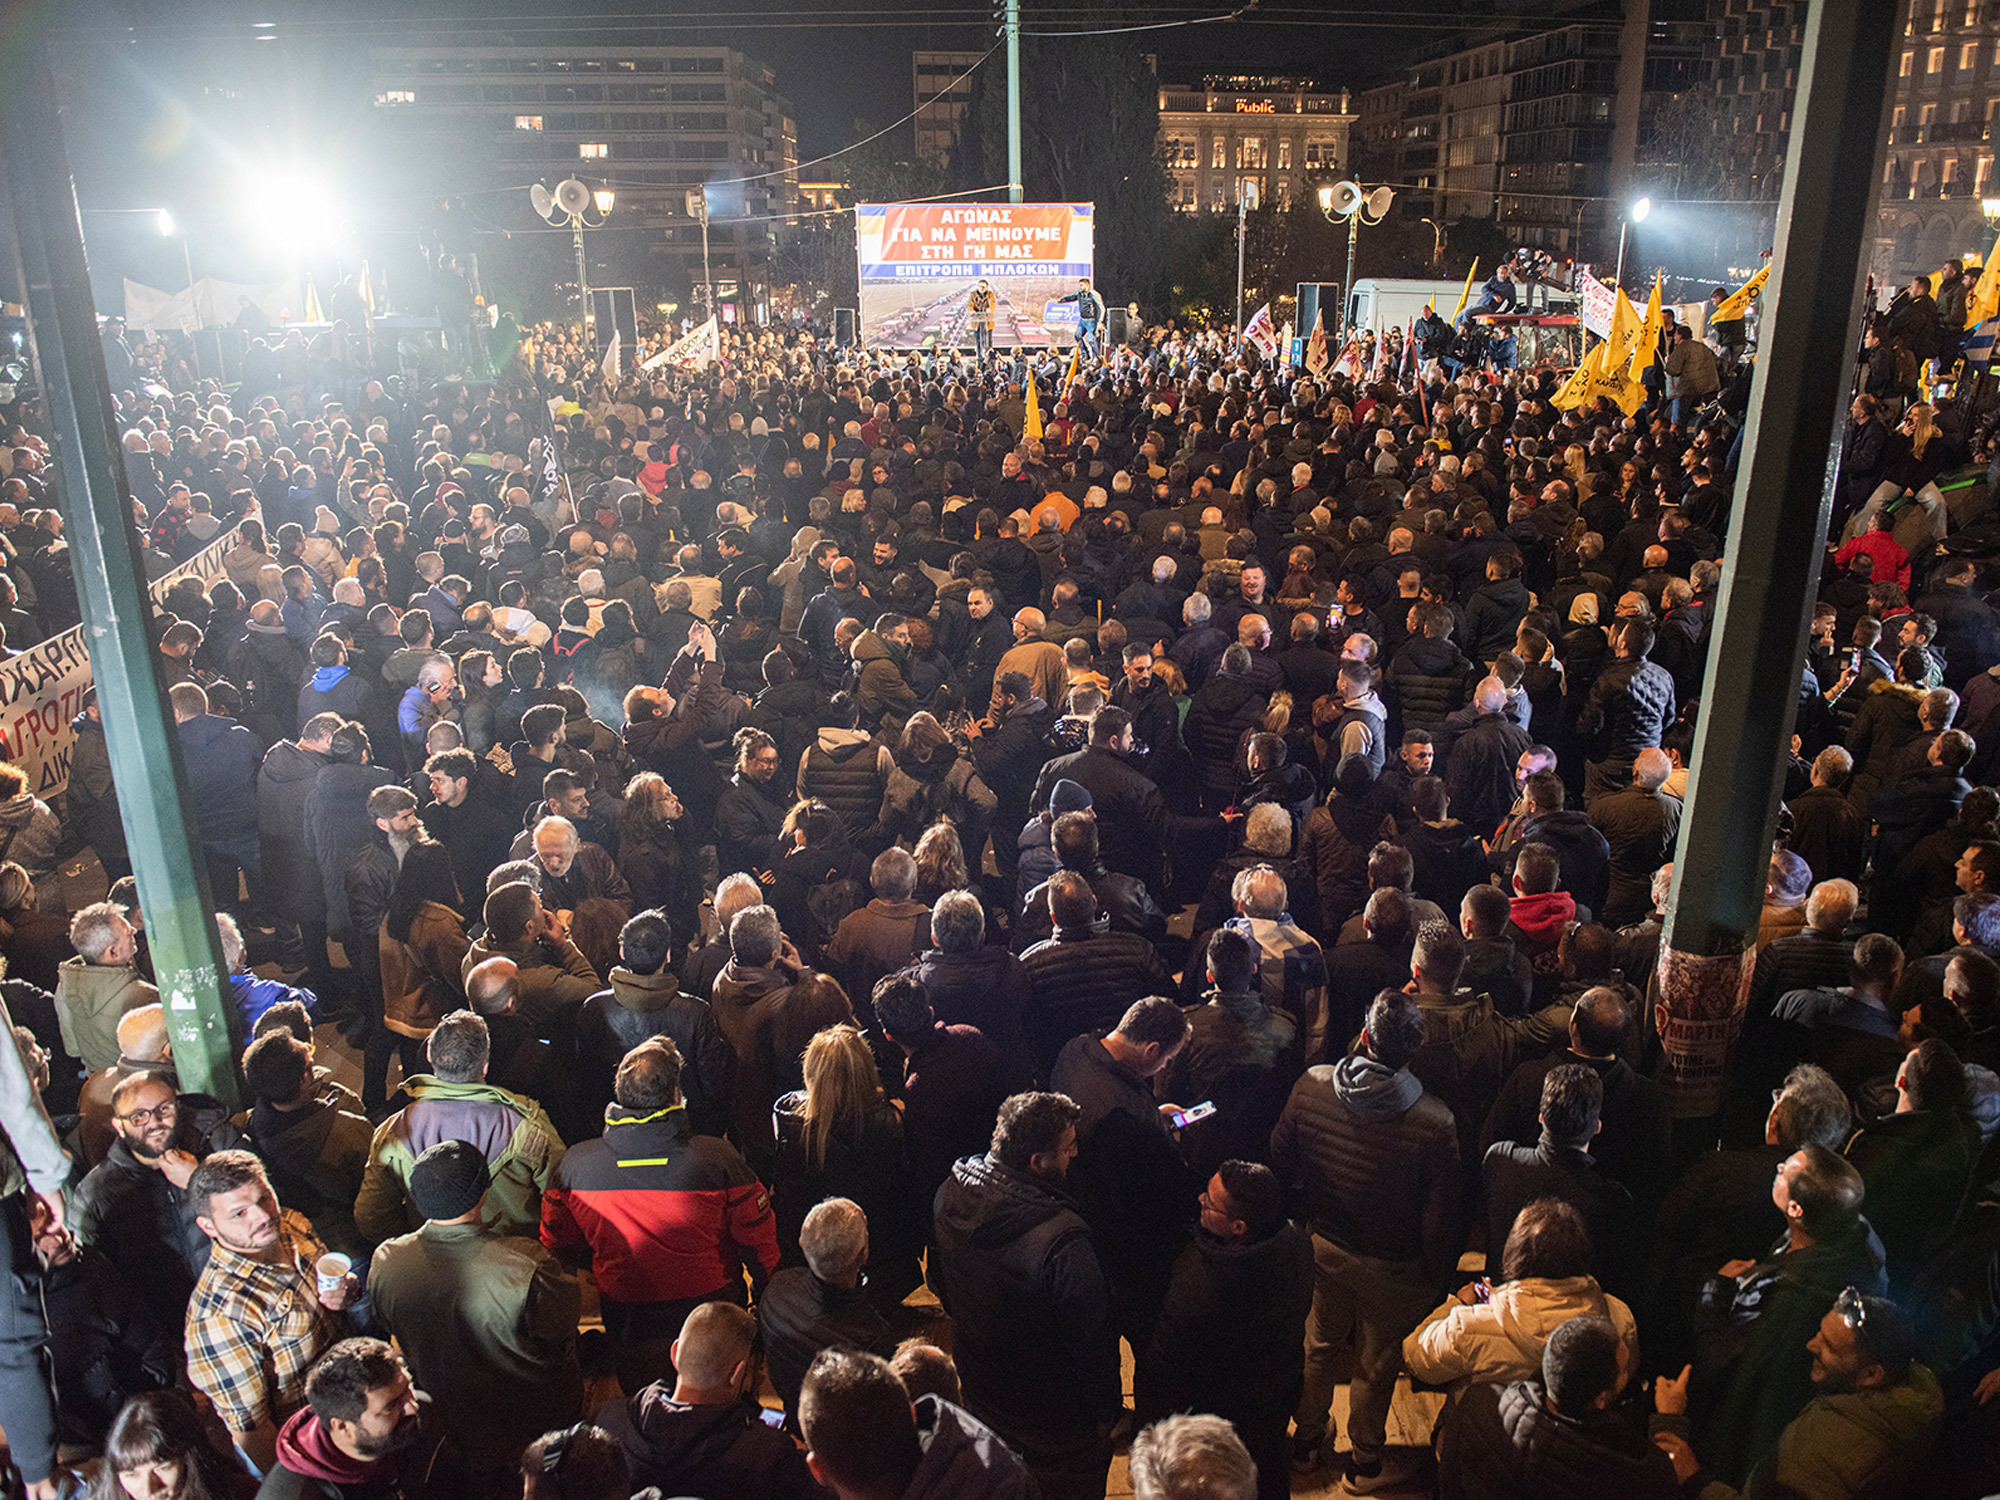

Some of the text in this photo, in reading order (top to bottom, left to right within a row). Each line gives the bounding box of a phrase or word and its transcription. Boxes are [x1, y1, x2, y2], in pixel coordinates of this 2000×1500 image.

[1236, 102, 1276, 113] Public
[941, 209, 1012, 224] ΑΓΩΝΑΣ
[892, 226, 1061, 242] ΓΙΑ ΝΑ ΜΕΙΝΟΥΜΕ
[920, 244, 1034, 259] ΣΤΗ ΓΗ ΜΑΣ
[895, 263, 1060, 276] ΕΠΙΤΡΟΠΗ ΜΠΛΟΚΩΝ
[39, 742, 77, 792] ΔΙΚ
